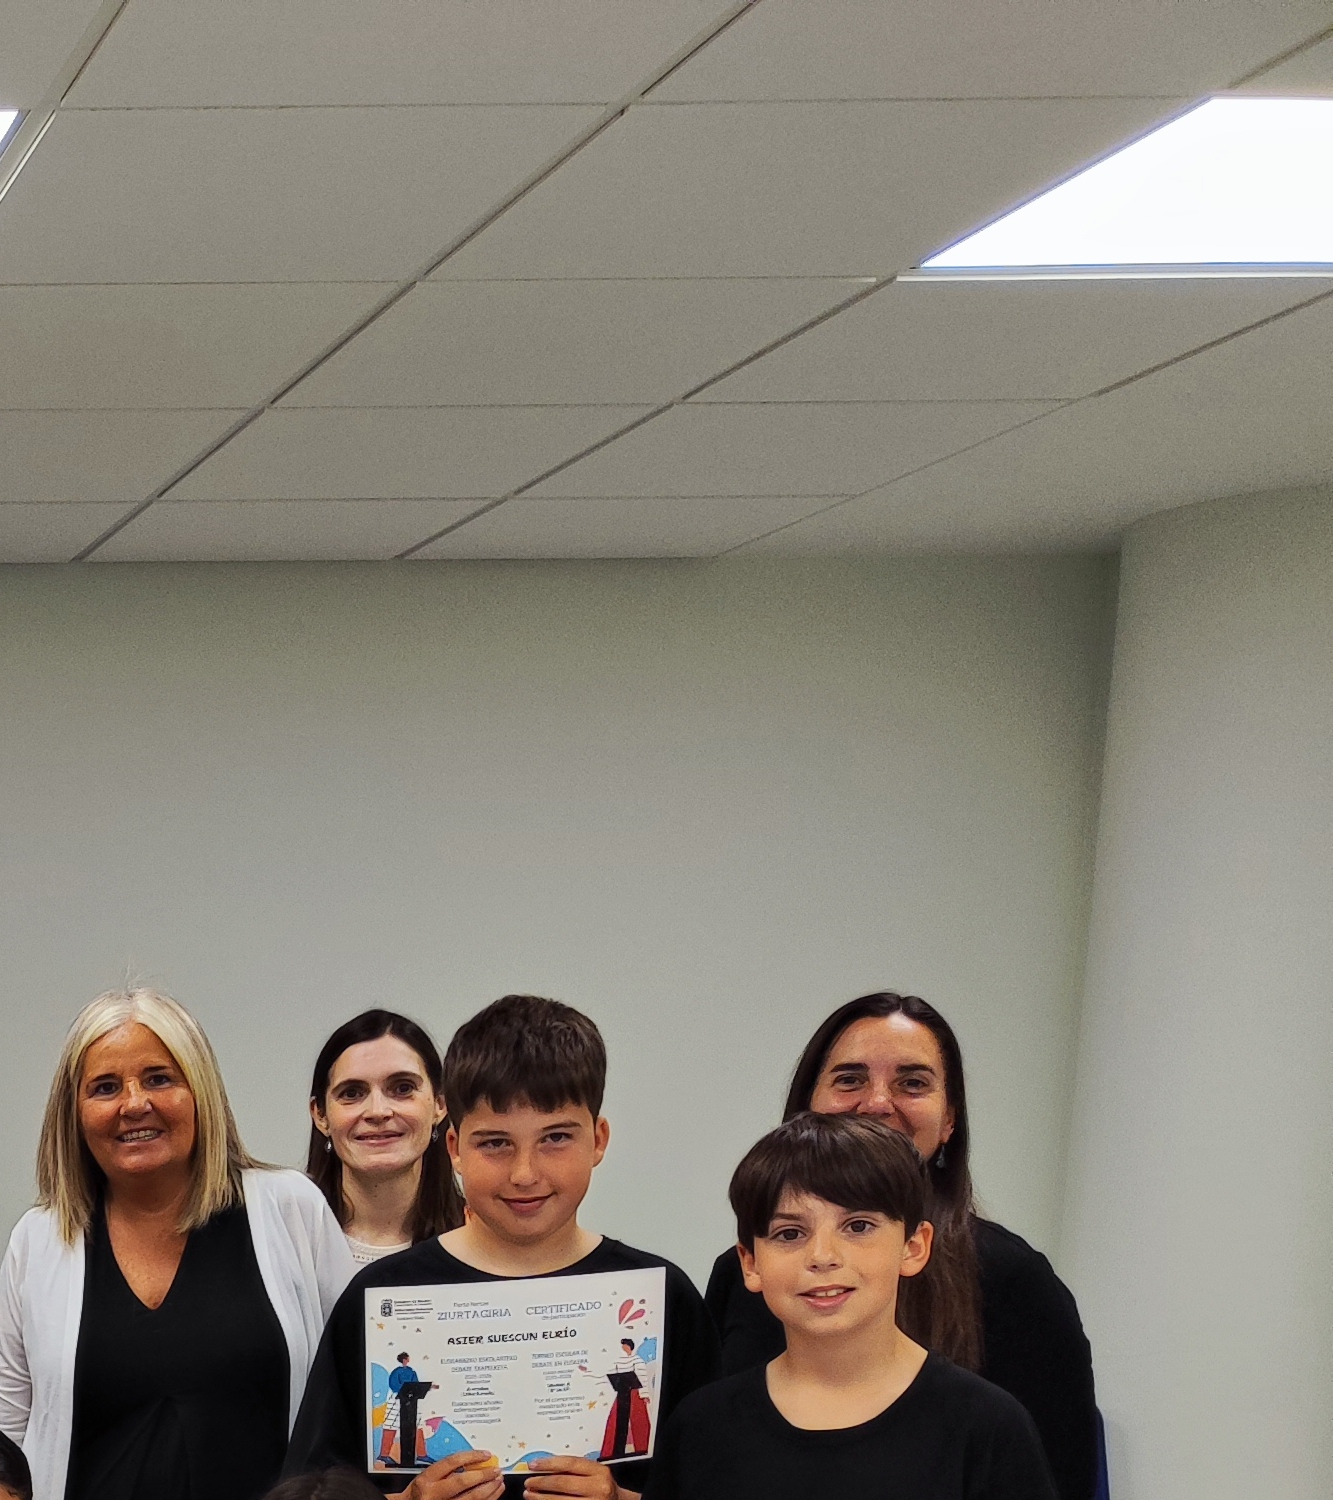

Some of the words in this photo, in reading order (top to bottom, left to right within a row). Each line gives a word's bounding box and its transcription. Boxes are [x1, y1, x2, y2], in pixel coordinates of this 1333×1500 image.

[437, 1308, 511, 1320] ZIURTAGIRIA
[525, 1301, 602, 1315] CERTIFICADO
[447, 1336, 483, 1345] ASIER
[487, 1332, 538, 1343] SUESCUN
